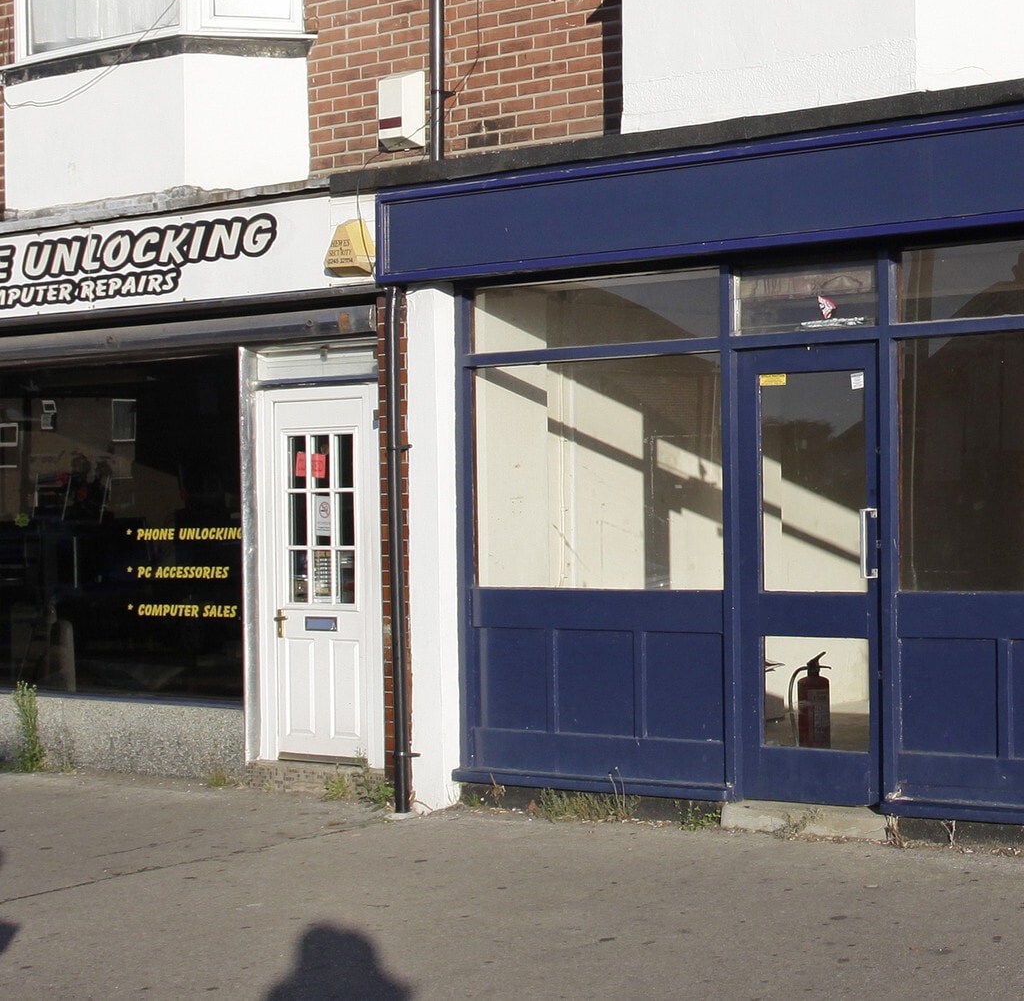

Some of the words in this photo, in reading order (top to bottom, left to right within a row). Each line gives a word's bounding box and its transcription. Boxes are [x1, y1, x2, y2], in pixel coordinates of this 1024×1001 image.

[22, 215, 276, 279] UNLOCKING
[79, 269, 180, 302] REPAIRS
[136, 527, 175, 541] PHONE
[137, 566, 152, 578] PC
[155, 566, 230, 580] ACCESSORIES
[137, 603, 199, 618] COMPUTER
[202, 605, 238, 618] SALES
